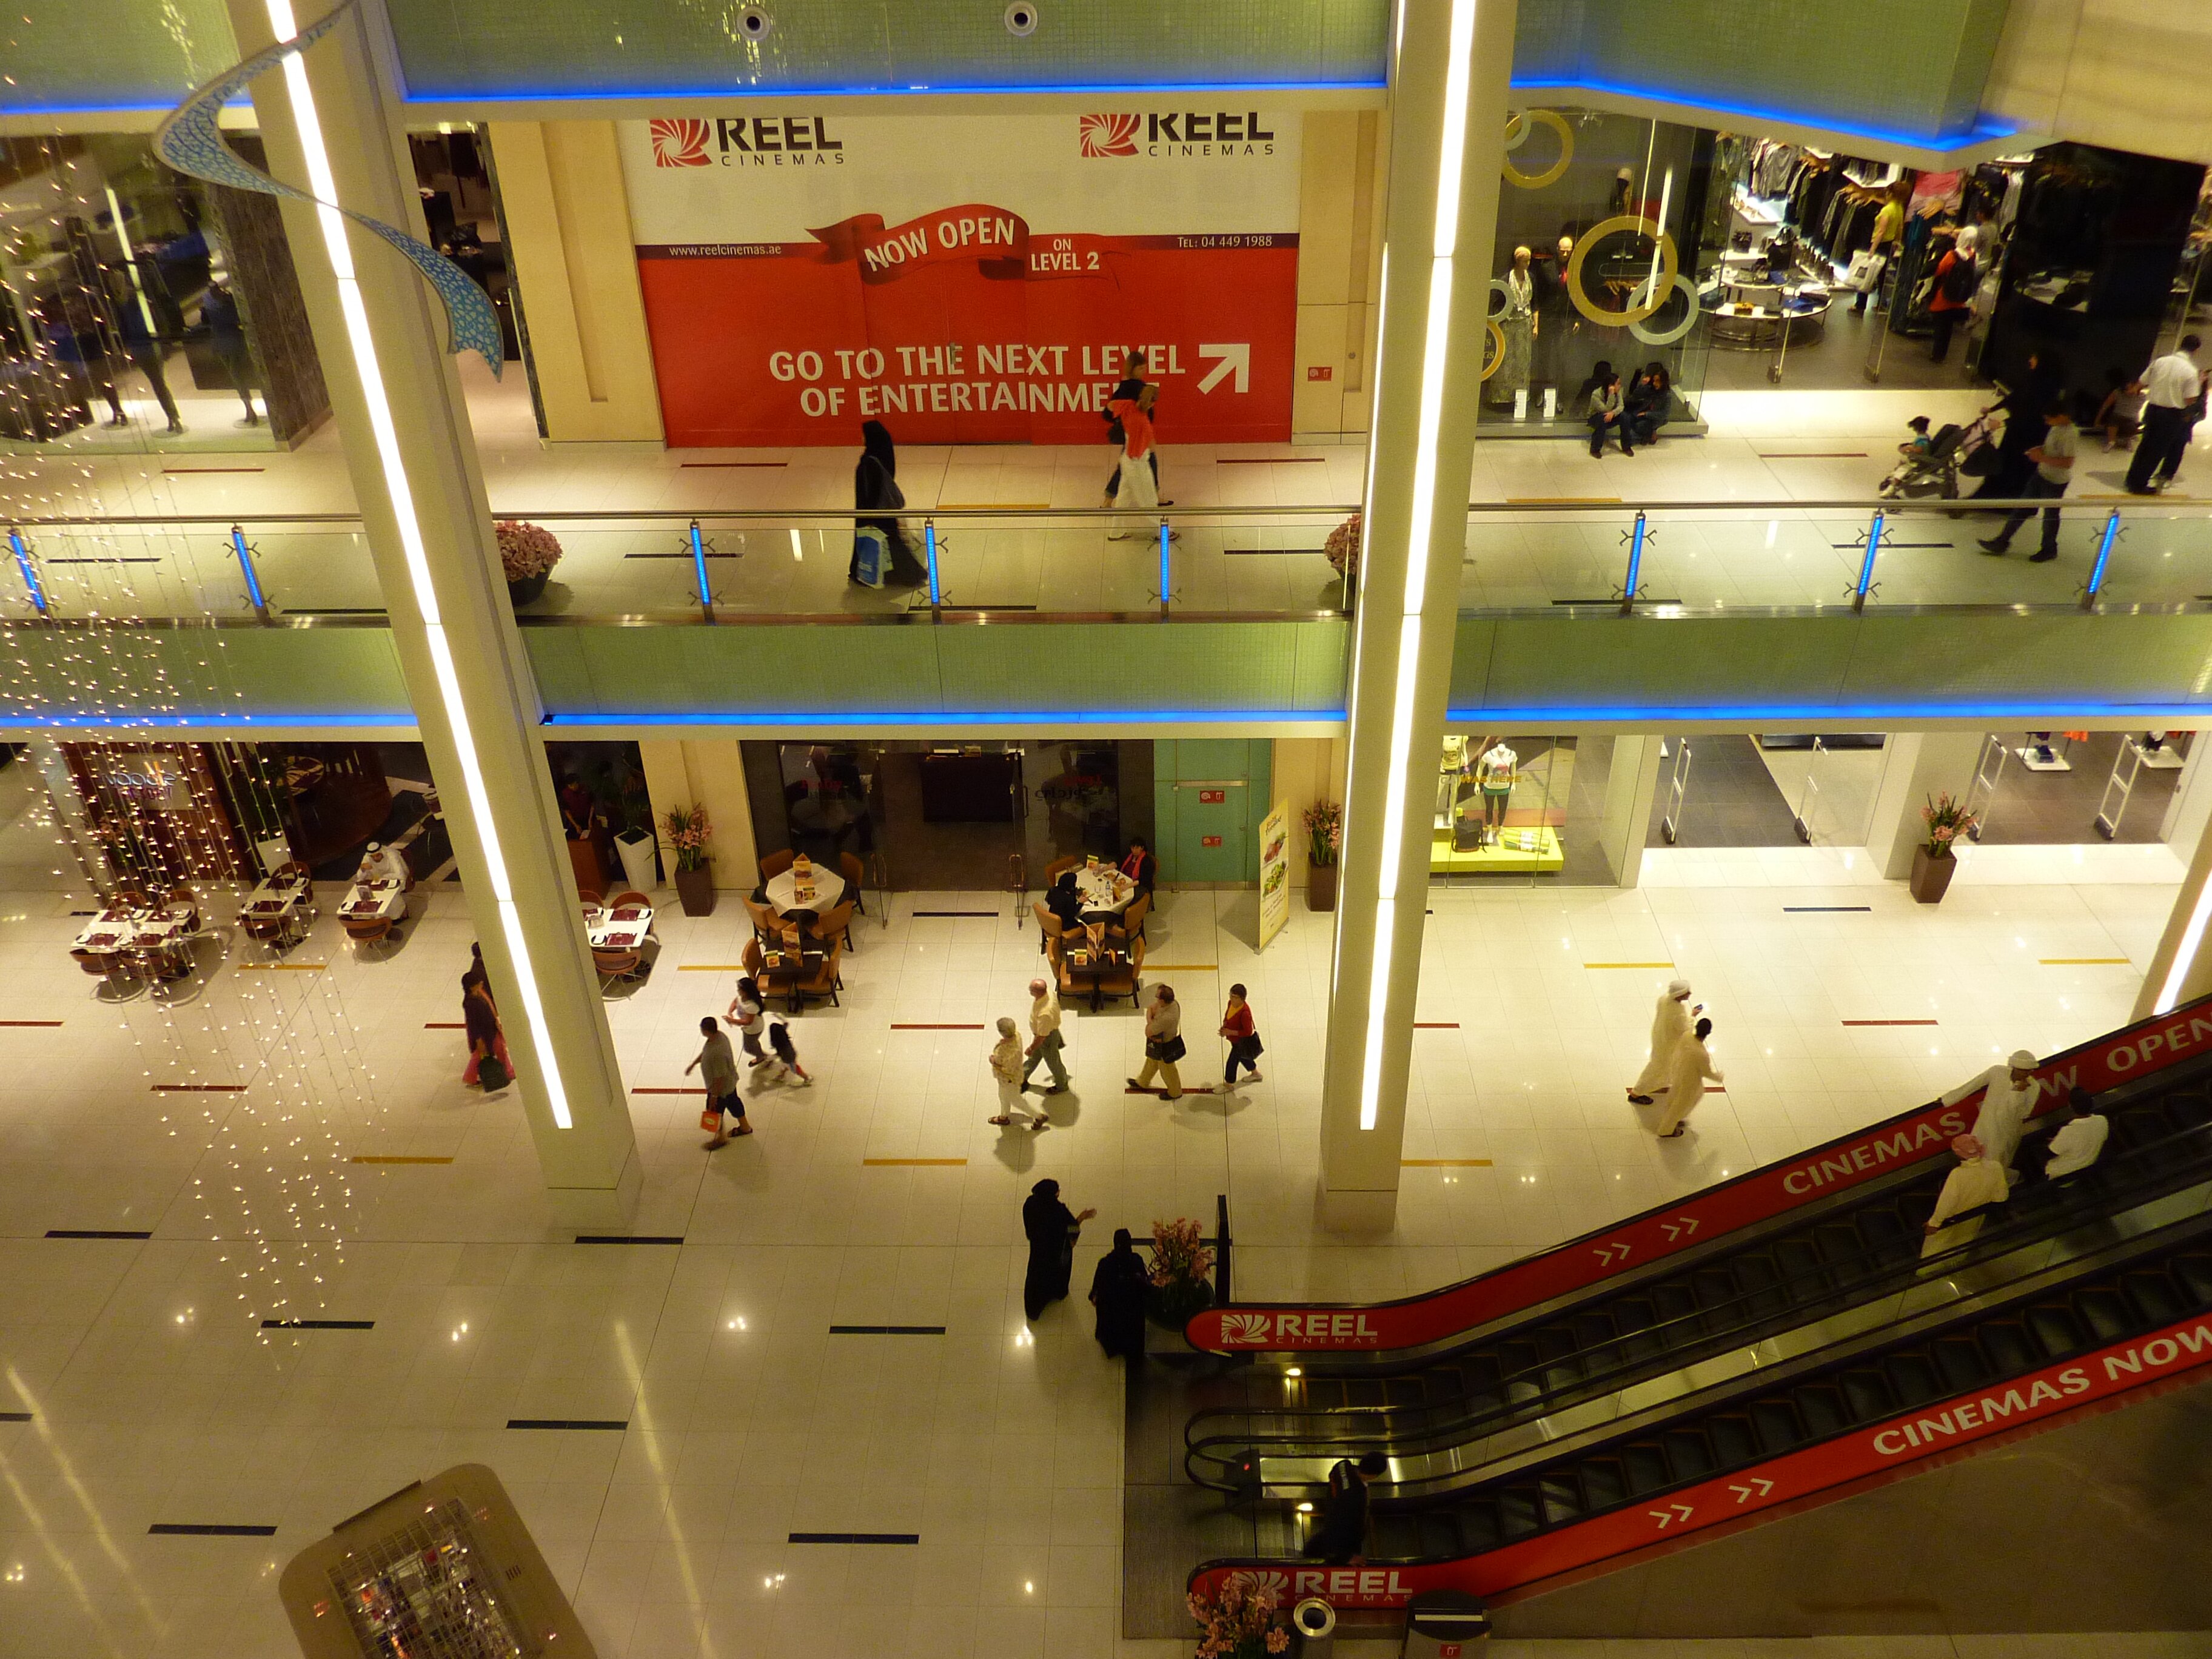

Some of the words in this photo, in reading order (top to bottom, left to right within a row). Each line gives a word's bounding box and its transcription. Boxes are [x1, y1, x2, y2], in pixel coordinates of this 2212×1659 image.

[716, 117, 843, 153] REEL
[1148, 112, 1274, 142] REEL
[721, 153, 844, 167] CINEMAS
[1148, 144, 1274, 157] CINEMAS
[669, 244, 782, 256] www.reelcinemas.ae
[864, 228, 928, 272] NOW
[938, 217, 1014, 249] OPEN
[1053, 238, 1071, 251] ON
[1201, 236, 1215, 247] 04
[1219, 236, 1241, 247] 449
[1245, 235, 1273, 247] 1988
[1031, 253, 1081, 272] LEVEL
[1087, 252, 1100, 270] 2
[769, 350, 824, 381] GO
[834, 347, 885, 380] TO
[896, 346, 965, 377] THE
[977, 344, 1069, 376] NEXT
[800, 387, 845, 417] OF
[859, 381, 1159, 416] ENTERTAINME
[1783, 1111, 1966, 1195] CINEMAS
[1276, 1315, 1378, 1336] REEL
[1873, 1367, 2090, 1455] CINEMAS
[1295, 1571, 1413, 1594] REEL
